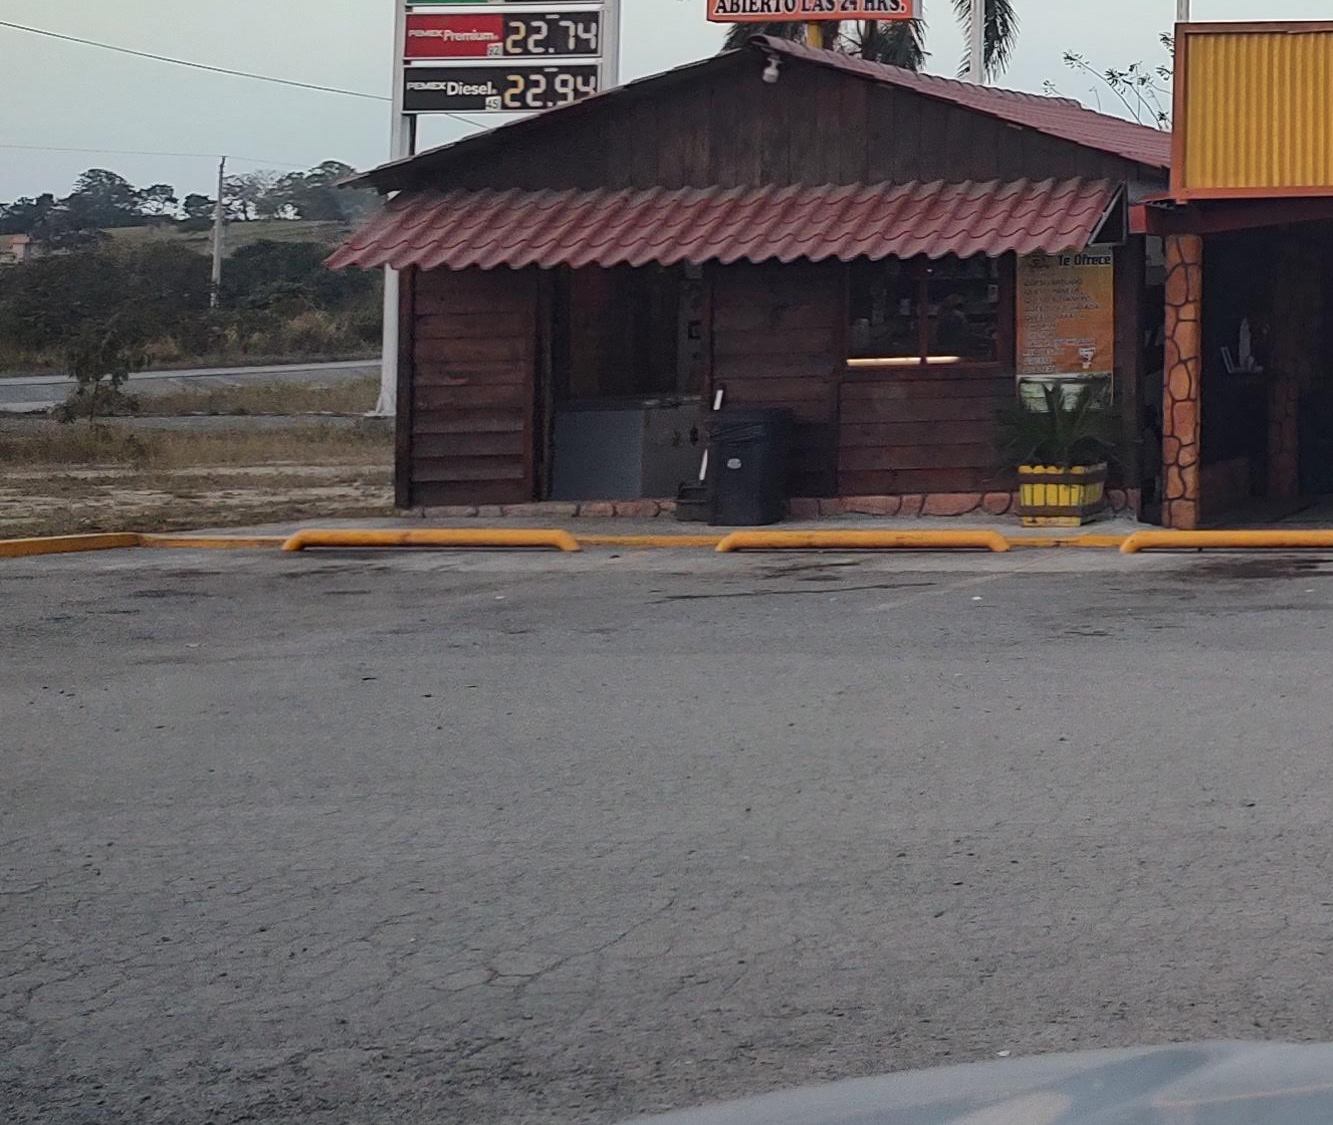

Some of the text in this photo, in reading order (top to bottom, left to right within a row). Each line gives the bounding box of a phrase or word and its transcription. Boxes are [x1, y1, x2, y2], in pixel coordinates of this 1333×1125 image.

[442, 28, 494, 42] Premium
[505, 21, 598, 54] 22.74
[406, 81, 492, 96] PEMEX Diesel
[504, 74, 596, 107] 22.94
[1058, 254, 1111, 266] Te Ofrece
